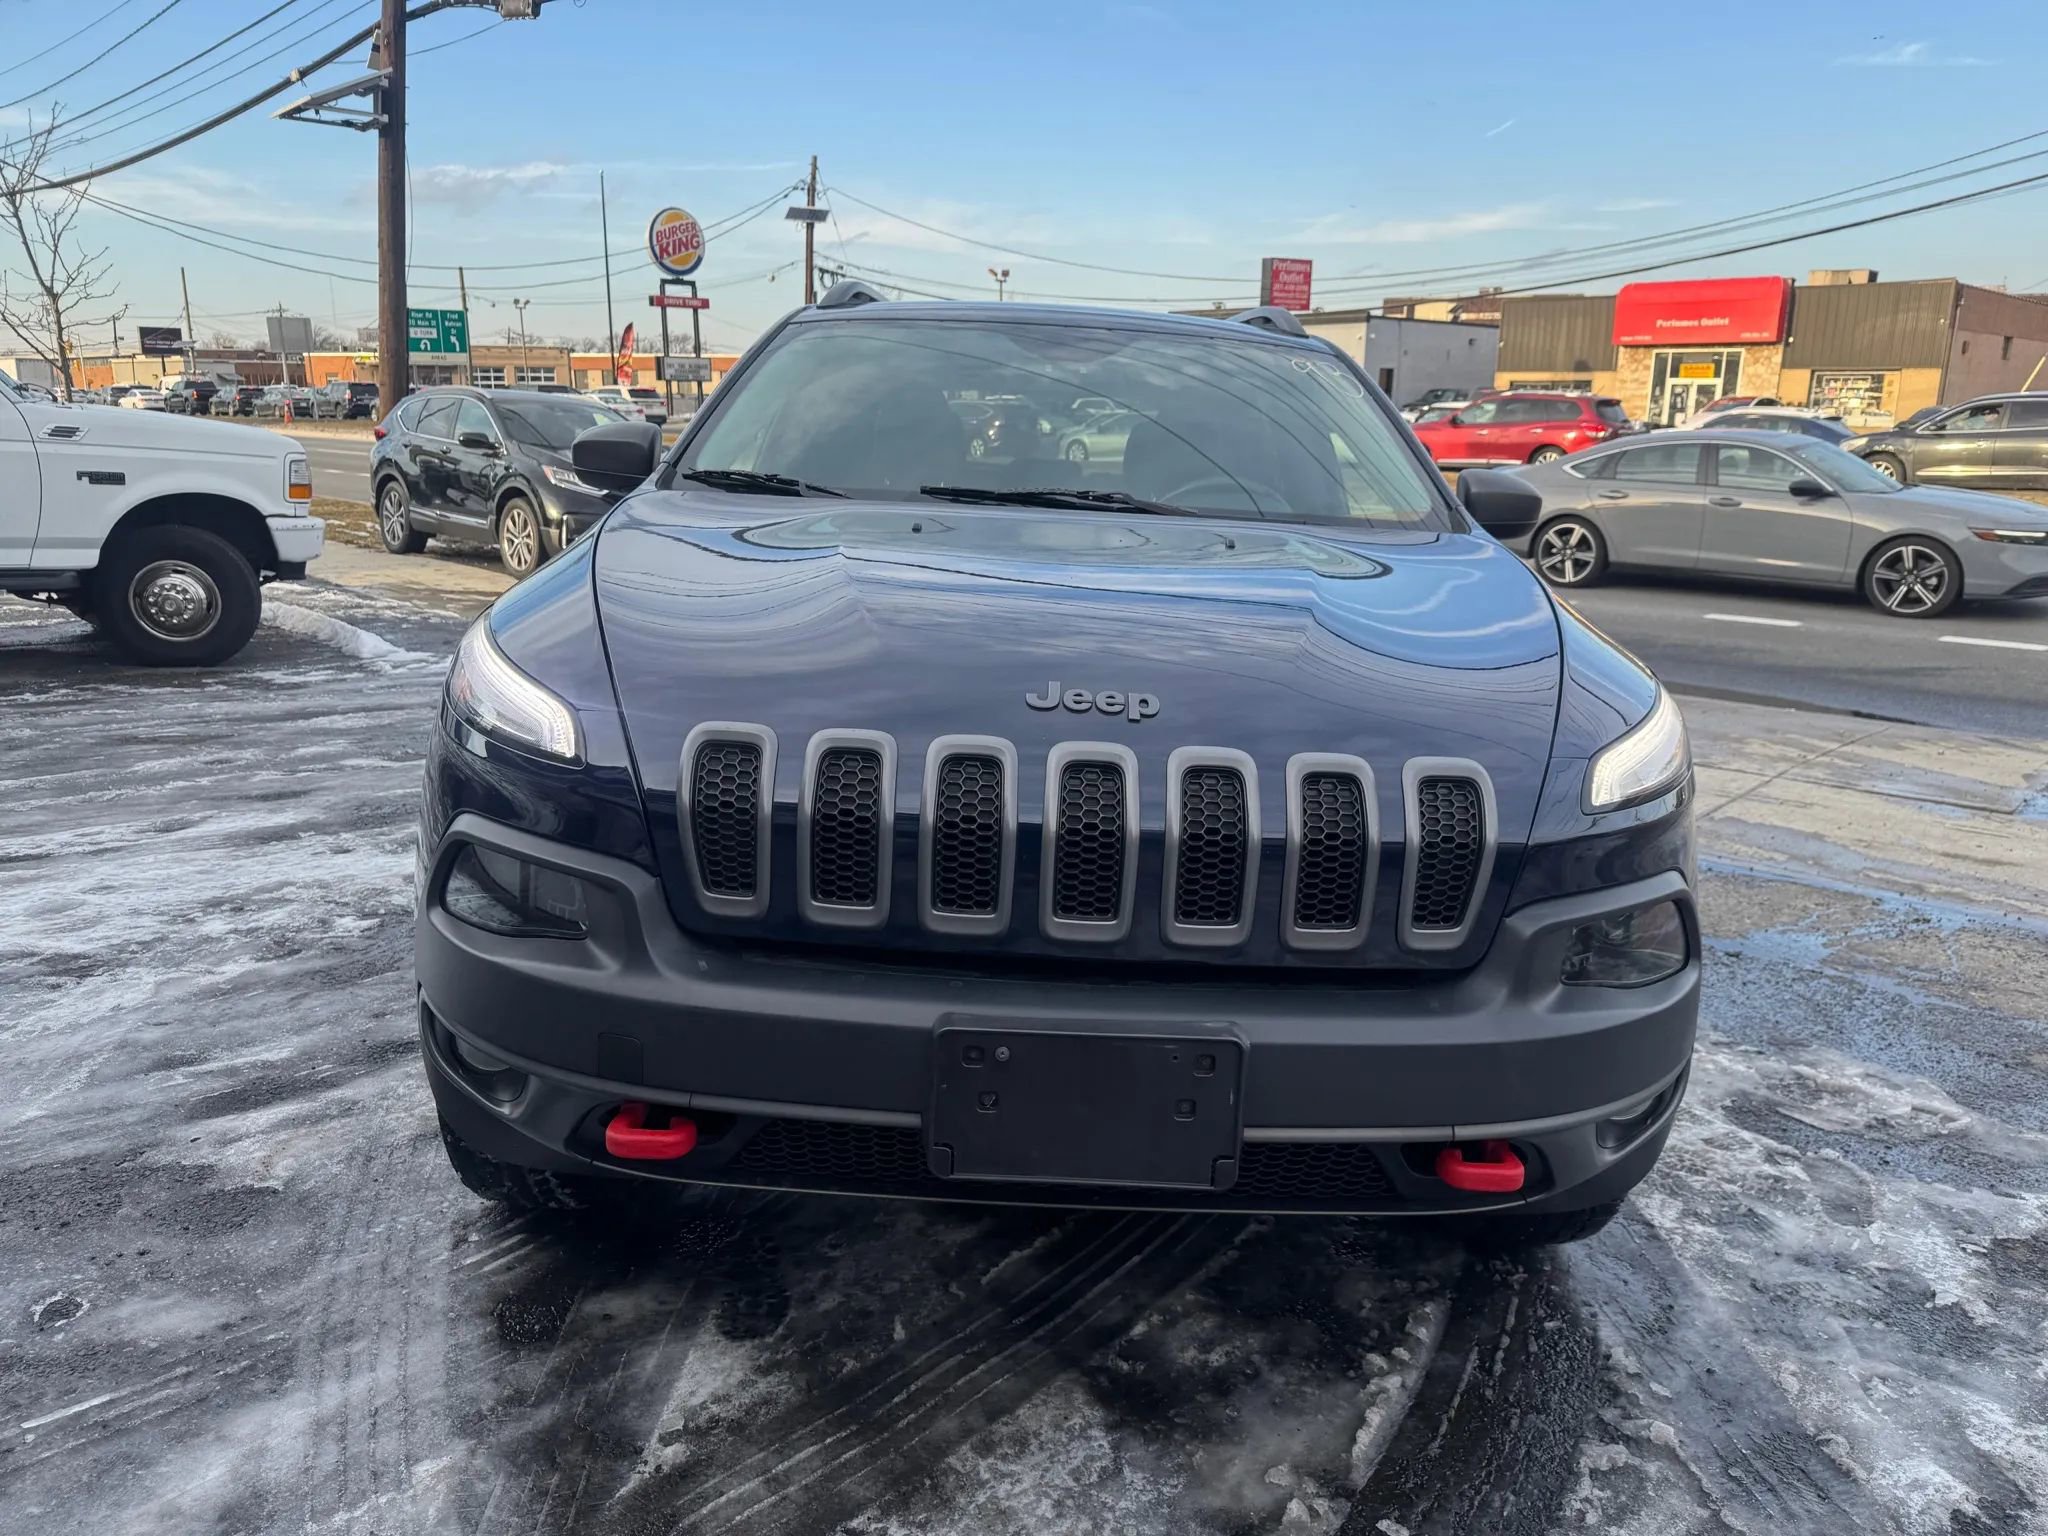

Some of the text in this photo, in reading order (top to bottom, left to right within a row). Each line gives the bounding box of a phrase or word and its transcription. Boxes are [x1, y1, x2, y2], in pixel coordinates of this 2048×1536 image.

[656, 221, 698, 244] BURGER
[658, 233, 700, 260] KING
[1273, 260, 1310, 272] Perfumes
[1279, 271, 1304, 285] Outlet
[685, 299, 702, 307] THRU
[1656, 317, 1729, 328] Perfumes Outlet
[1025, 680, 1160, 722] Jeep
